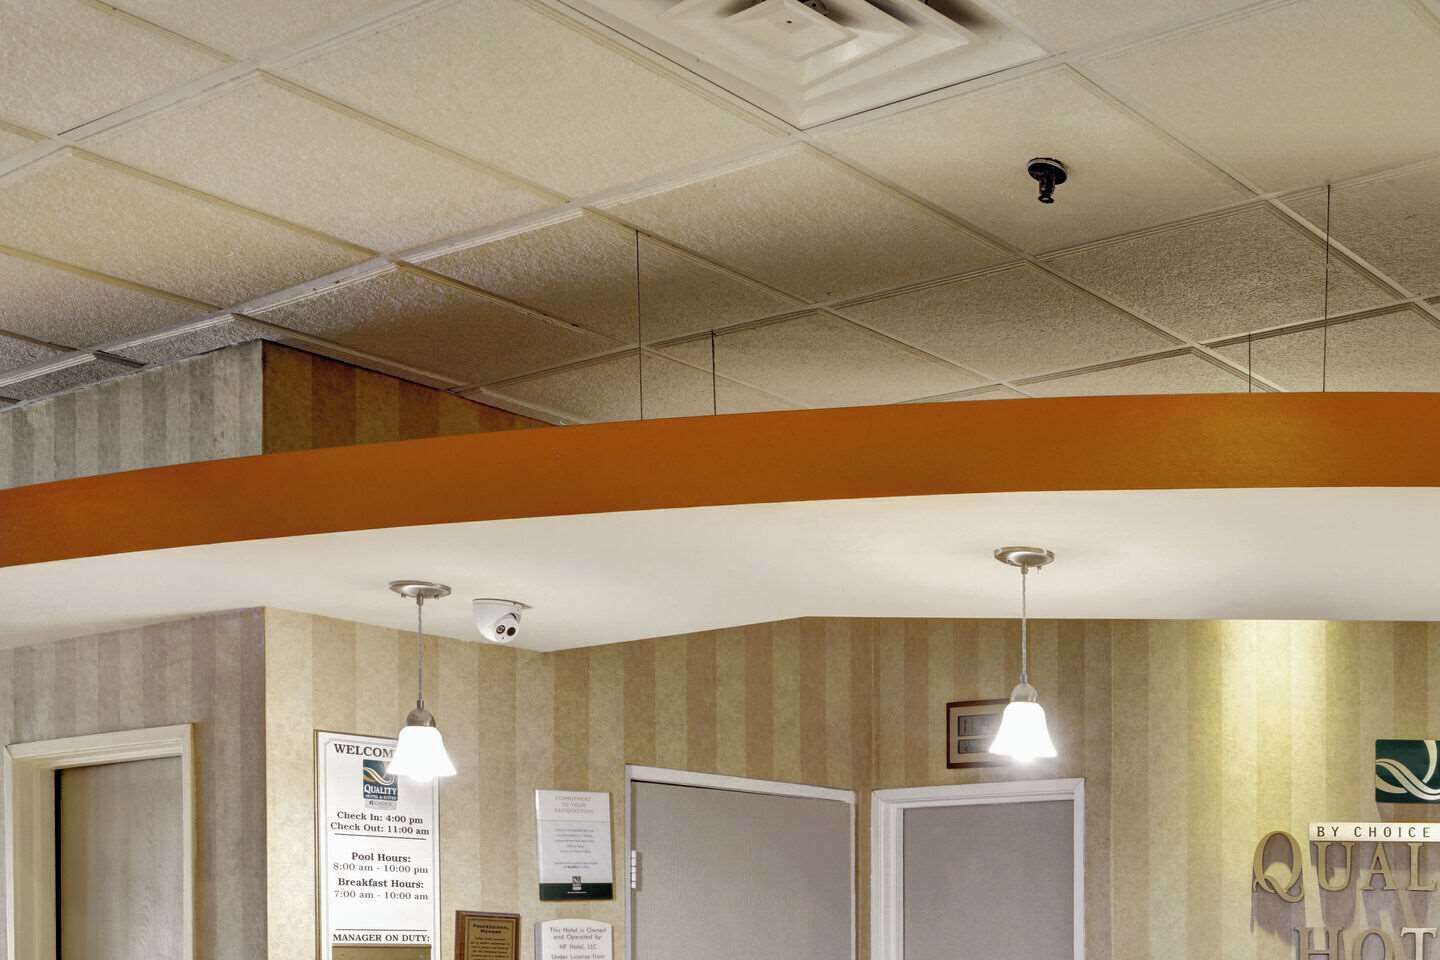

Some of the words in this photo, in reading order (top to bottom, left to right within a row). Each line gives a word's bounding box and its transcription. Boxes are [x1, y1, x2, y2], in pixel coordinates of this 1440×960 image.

[334, 743, 394, 758] WELCOM
[364, 784, 397, 795] QUALITY
[337, 811, 367, 820] Check
[386, 814, 406, 823] 4:00
[409, 817, 423, 825] pm
[330, 822, 360, 831] Check
[364, 824, 384, 832] Out:
[387, 826, 413, 834] 11:00
[1316, 826, 1340, 838] BY
[1354, 826, 1431, 838] CHOICE
[352, 852, 374, 860] Pool
[378, 854, 411, 862] Hours:
[333, 862, 355, 870] 8:00
[384, 865, 411, 873] 10:00
[338, 878, 388, 887] Breakfast
[391, 880, 424, 888] Hours:
[384, 891, 411, 900] 10:00
[333, 934, 382, 942] MANAGER
[385, 934, 399, 942] ON
[402, 934, 430, 942] DUTY:
